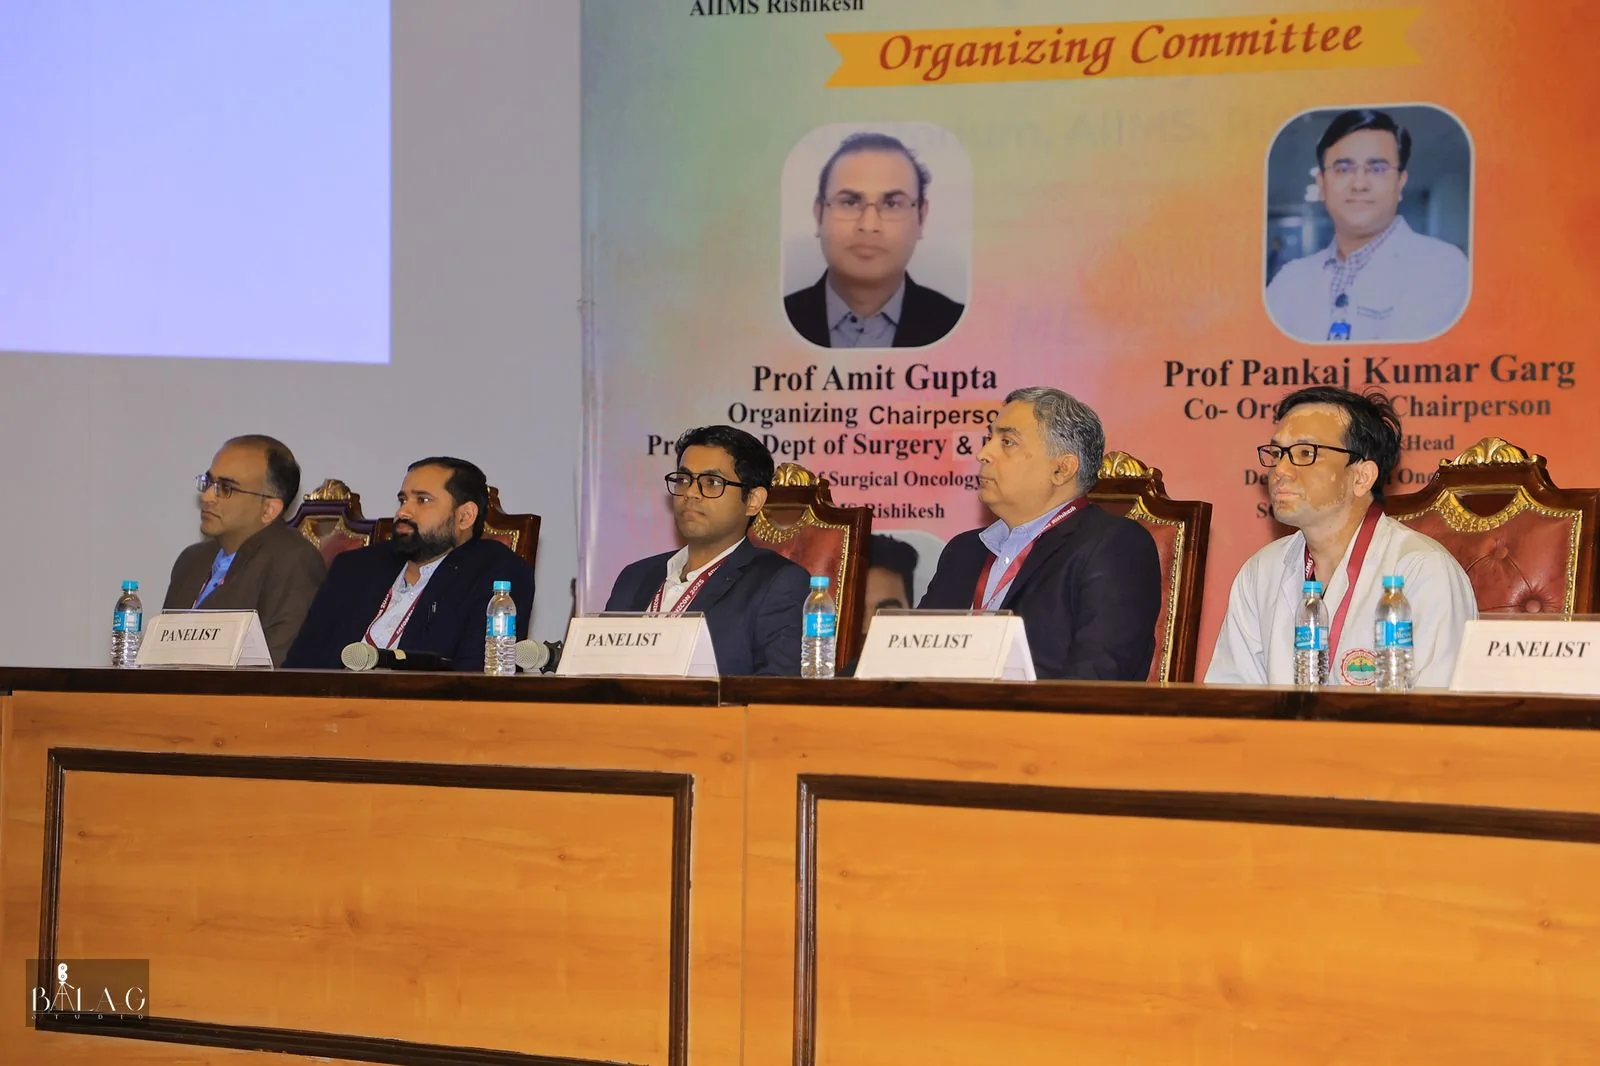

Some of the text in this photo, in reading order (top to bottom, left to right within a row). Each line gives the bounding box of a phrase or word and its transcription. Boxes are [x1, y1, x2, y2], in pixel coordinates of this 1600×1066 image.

[690, 0, 759, 16] AIIMS
[879, 17, 1363, 81] Organizing Committee
[752, 363, 998, 397] Prof Amit Gupta
[1164, 354, 1577, 389] Prof Pankaj Kumar Garg
[728, 402, 999, 430] Organizing Chairperso
[1184, 398, 1229, 421] Co-
[824, 434, 848, 455] of
[853, 433, 947, 460] Surgery
[956, 435, 973, 455] &
[829, 470, 898, 490] Surgical
[160, 628, 221, 642] PANELIST
[585, 632, 661, 647] PANELIST
[887, 634, 972, 649] PANELIST
[1487, 641, 1590, 658] PANELIST
